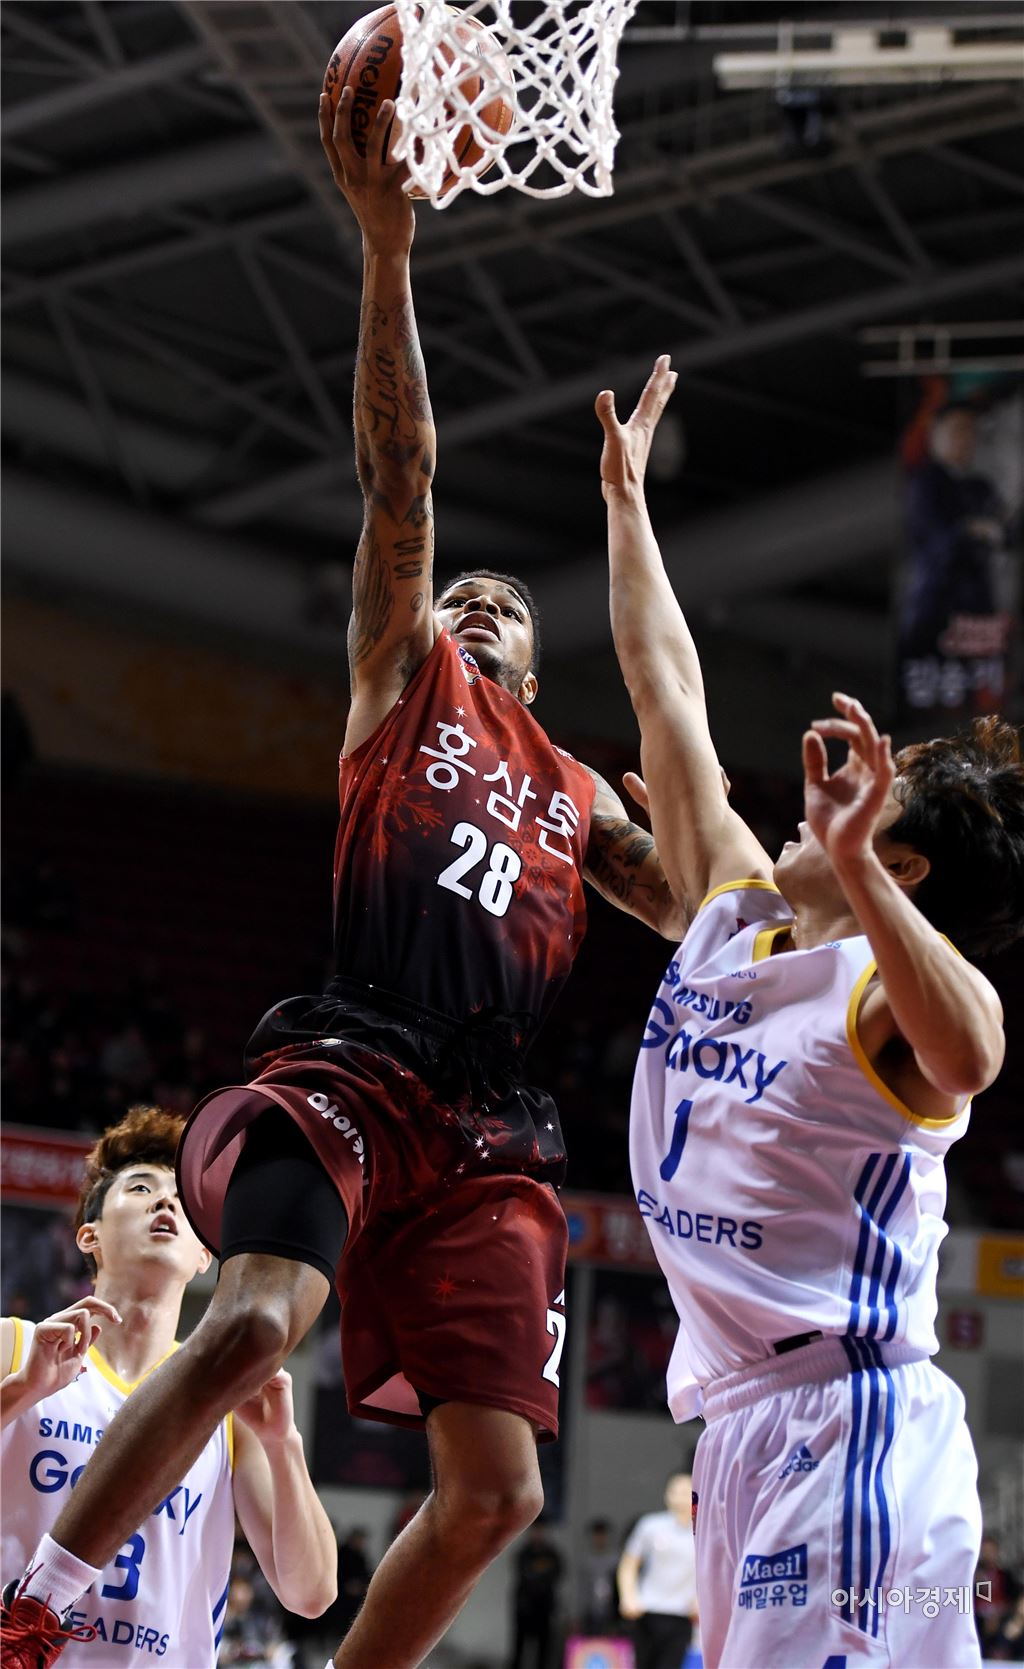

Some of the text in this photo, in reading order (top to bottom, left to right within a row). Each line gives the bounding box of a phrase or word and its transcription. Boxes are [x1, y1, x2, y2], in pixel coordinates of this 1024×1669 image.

[351, 35, 394, 159] molten
[419, 721, 580, 866] 홍삼톤
[436, 821, 523, 918] 28
[641, 997, 787, 1104] Gaaxy
[660, 1098, 693, 1182] 1
[637, 1189, 763, 1251] EADERS
[39, 1417, 104, 1445] SAMS
[29, 1449, 202, 1535] Gxy
[738, 1583, 808, 1610] 매일유업
[742, 1553, 802, 1583] Maeil
[69, 1611, 170, 1656] EADERS
